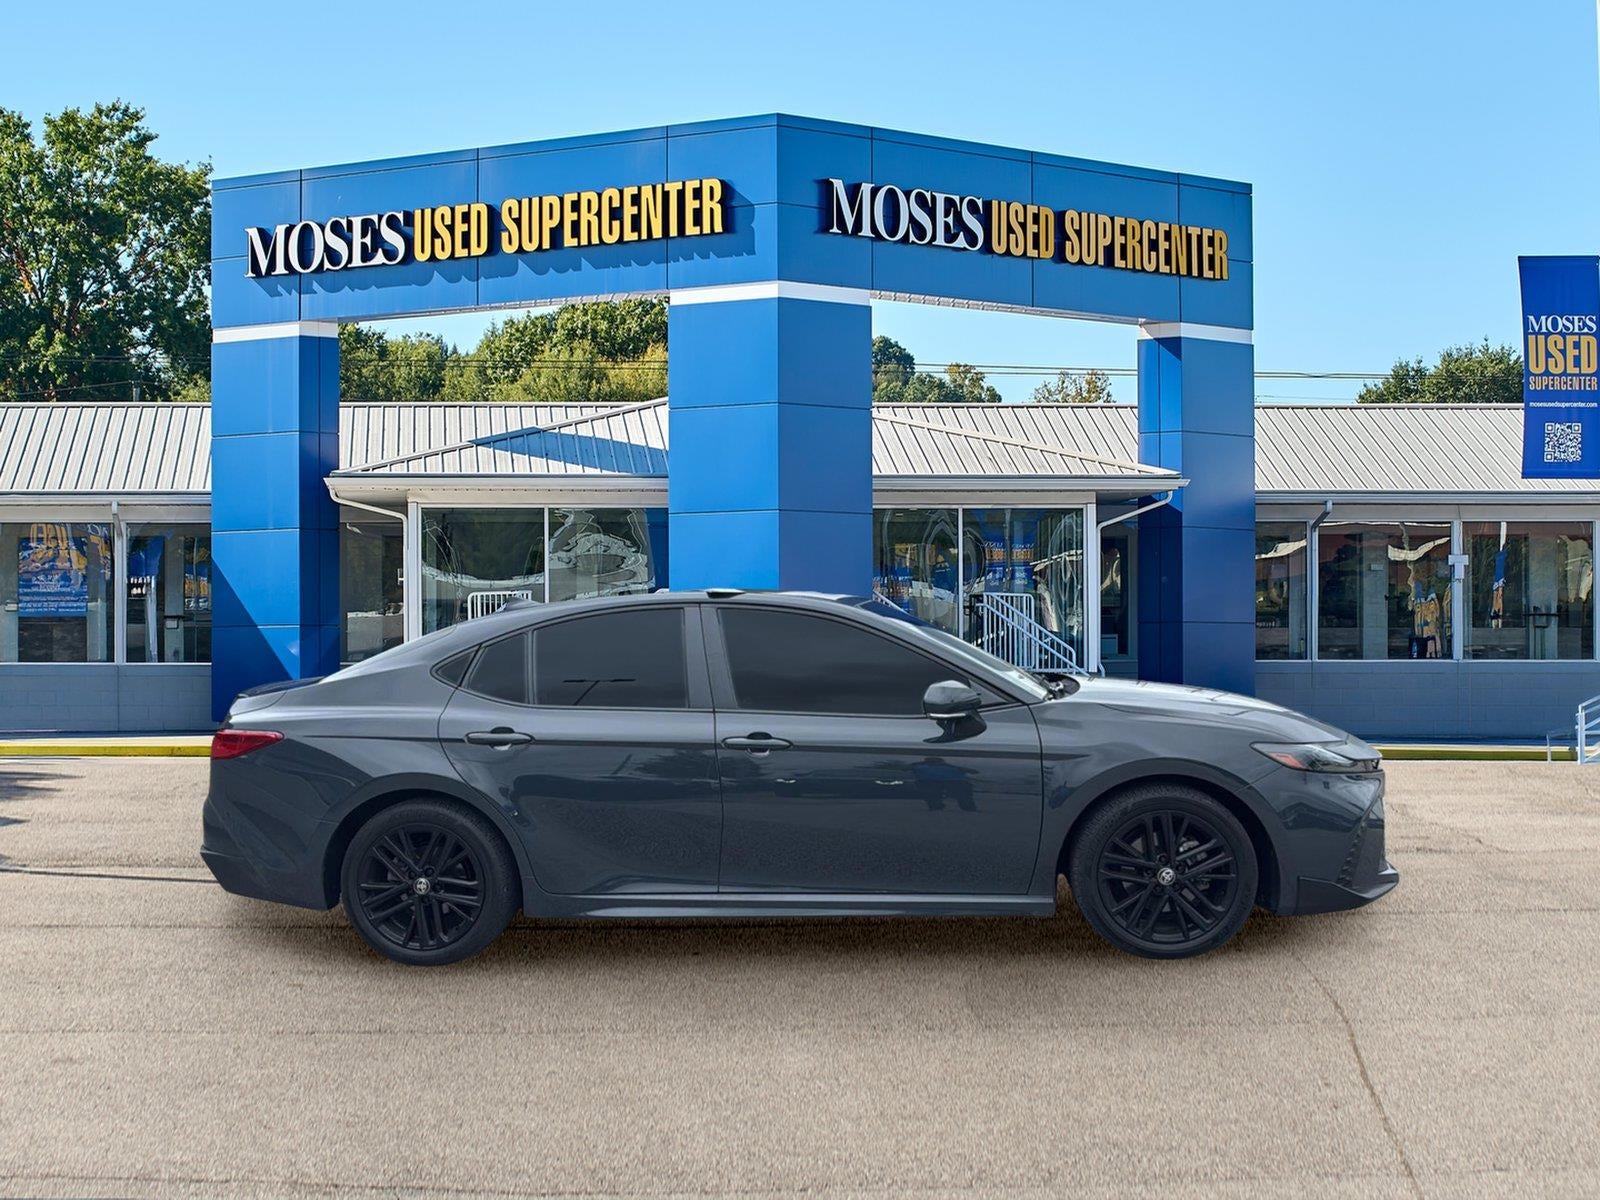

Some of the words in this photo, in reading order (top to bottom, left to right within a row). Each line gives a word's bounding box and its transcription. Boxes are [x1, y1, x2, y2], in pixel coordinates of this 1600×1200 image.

[243, 211, 407, 278] MOSES
[412, 203, 489, 262] USED
[500, 178, 724, 253] SUPERCENTER
[828, 178, 985, 251] MOSES
[990, 200, 1055, 259] USED
[1064, 209, 1229, 280] SUPERCENTER
[1527, 315, 1597, 334] MOSES
[1528, 335, 1598, 374] USED
[1529, 376, 1598, 391] SUPERCENTER
